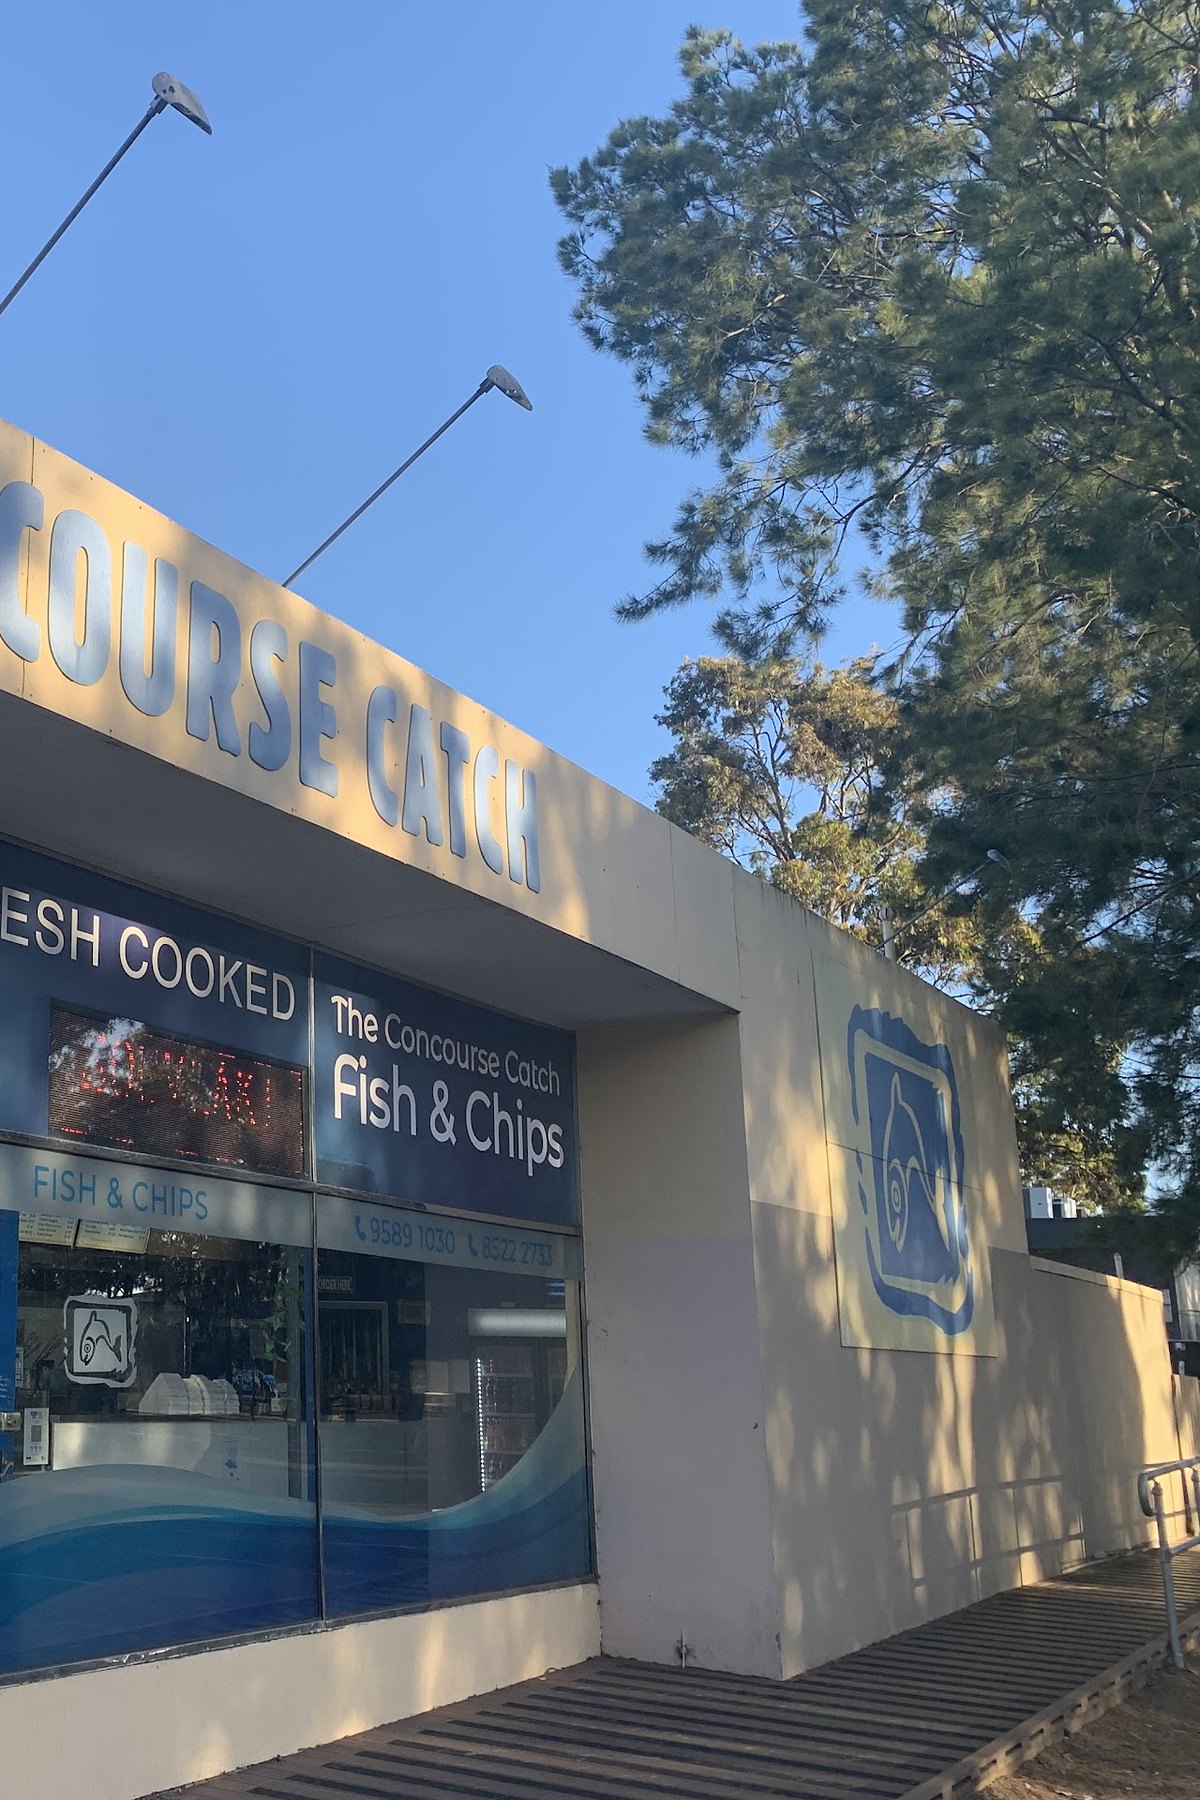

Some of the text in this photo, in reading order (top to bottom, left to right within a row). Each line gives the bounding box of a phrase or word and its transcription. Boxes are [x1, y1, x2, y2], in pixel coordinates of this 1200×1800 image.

[366, 685, 540, 893] CATCH
[119, 926, 295, 1021] COOKED
[331, 995, 561, 1096] The Concourse Catch
[334, 1053, 417, 1136] Fish
[429, 1080, 457, 1146] &
[465, 1090, 565, 1177] Chips
[33, 1165, 208, 1221] FISH & CHIPS
[370, 1217, 553, 1266] 9589 1030 8522 2733
